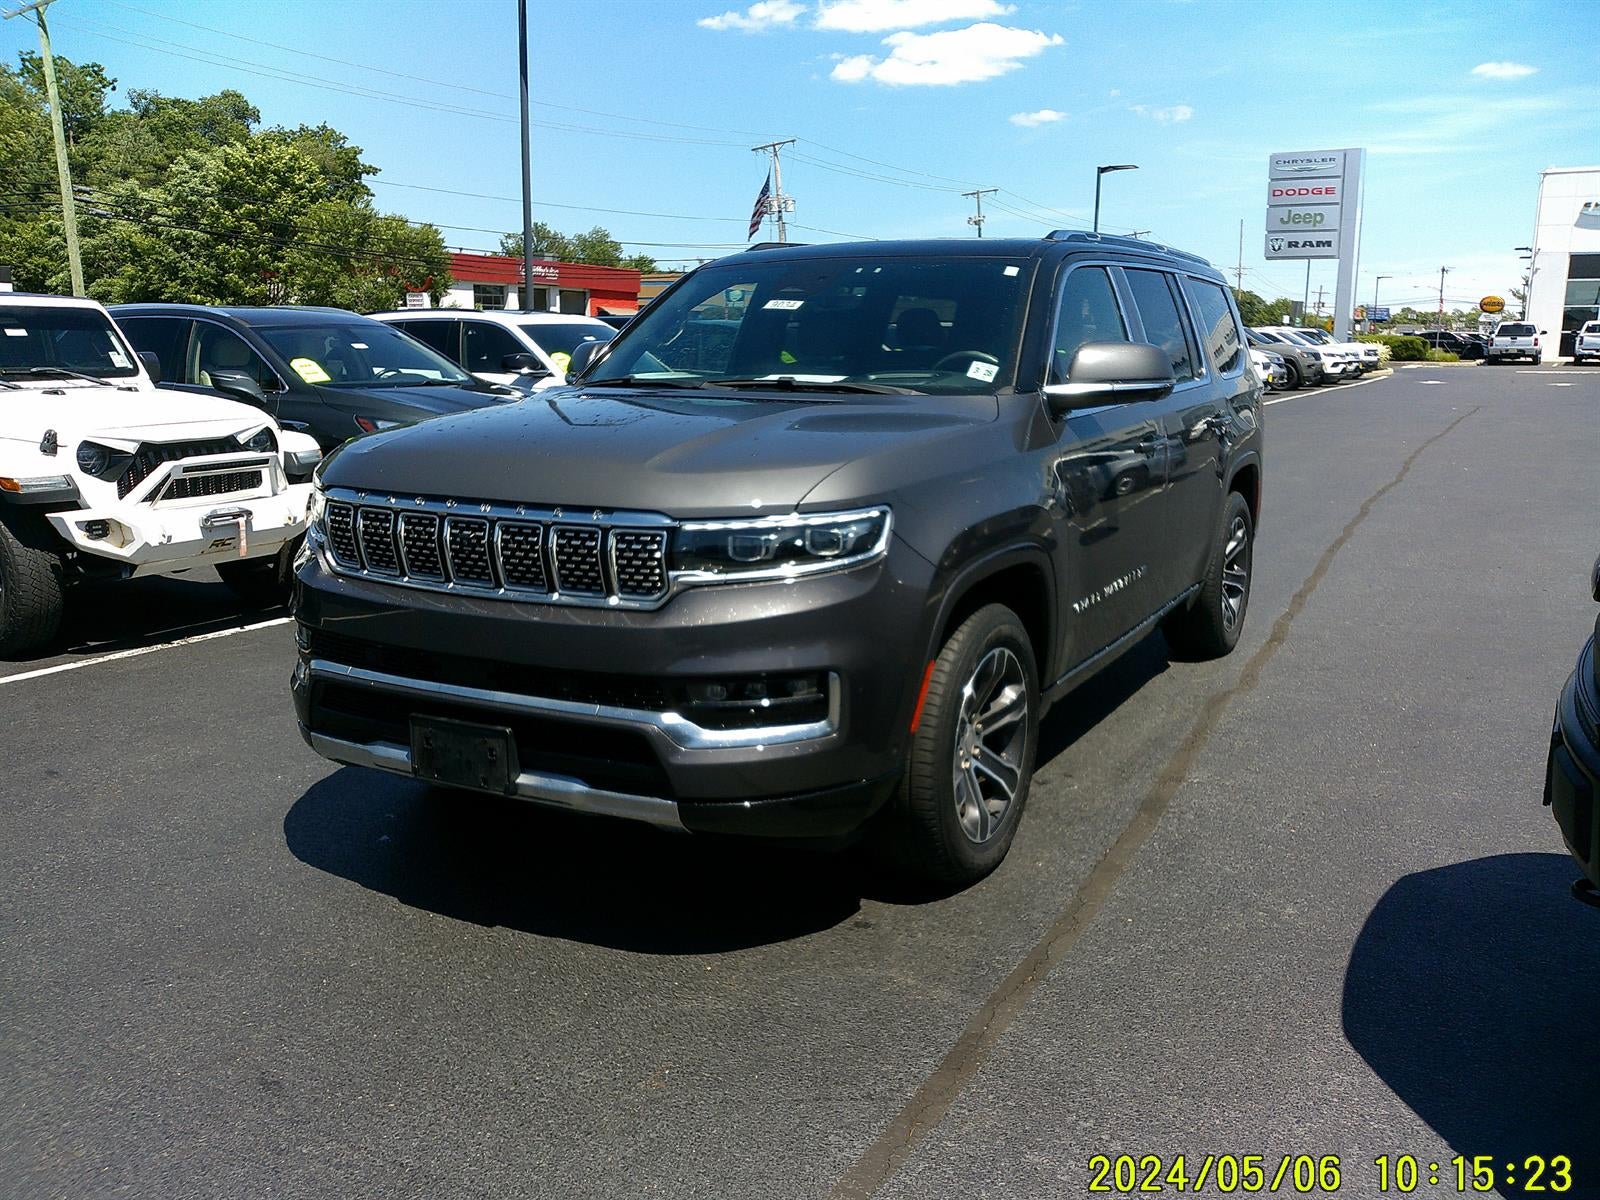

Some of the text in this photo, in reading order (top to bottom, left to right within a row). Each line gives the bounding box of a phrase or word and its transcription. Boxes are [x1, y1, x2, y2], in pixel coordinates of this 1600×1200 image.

[1275, 157, 1337, 165] CHRYSLER
[1271, 186, 1337, 197] DODGE
[1280, 209, 1325, 227] Jeep
[1287, 240, 1333, 249] RAM
